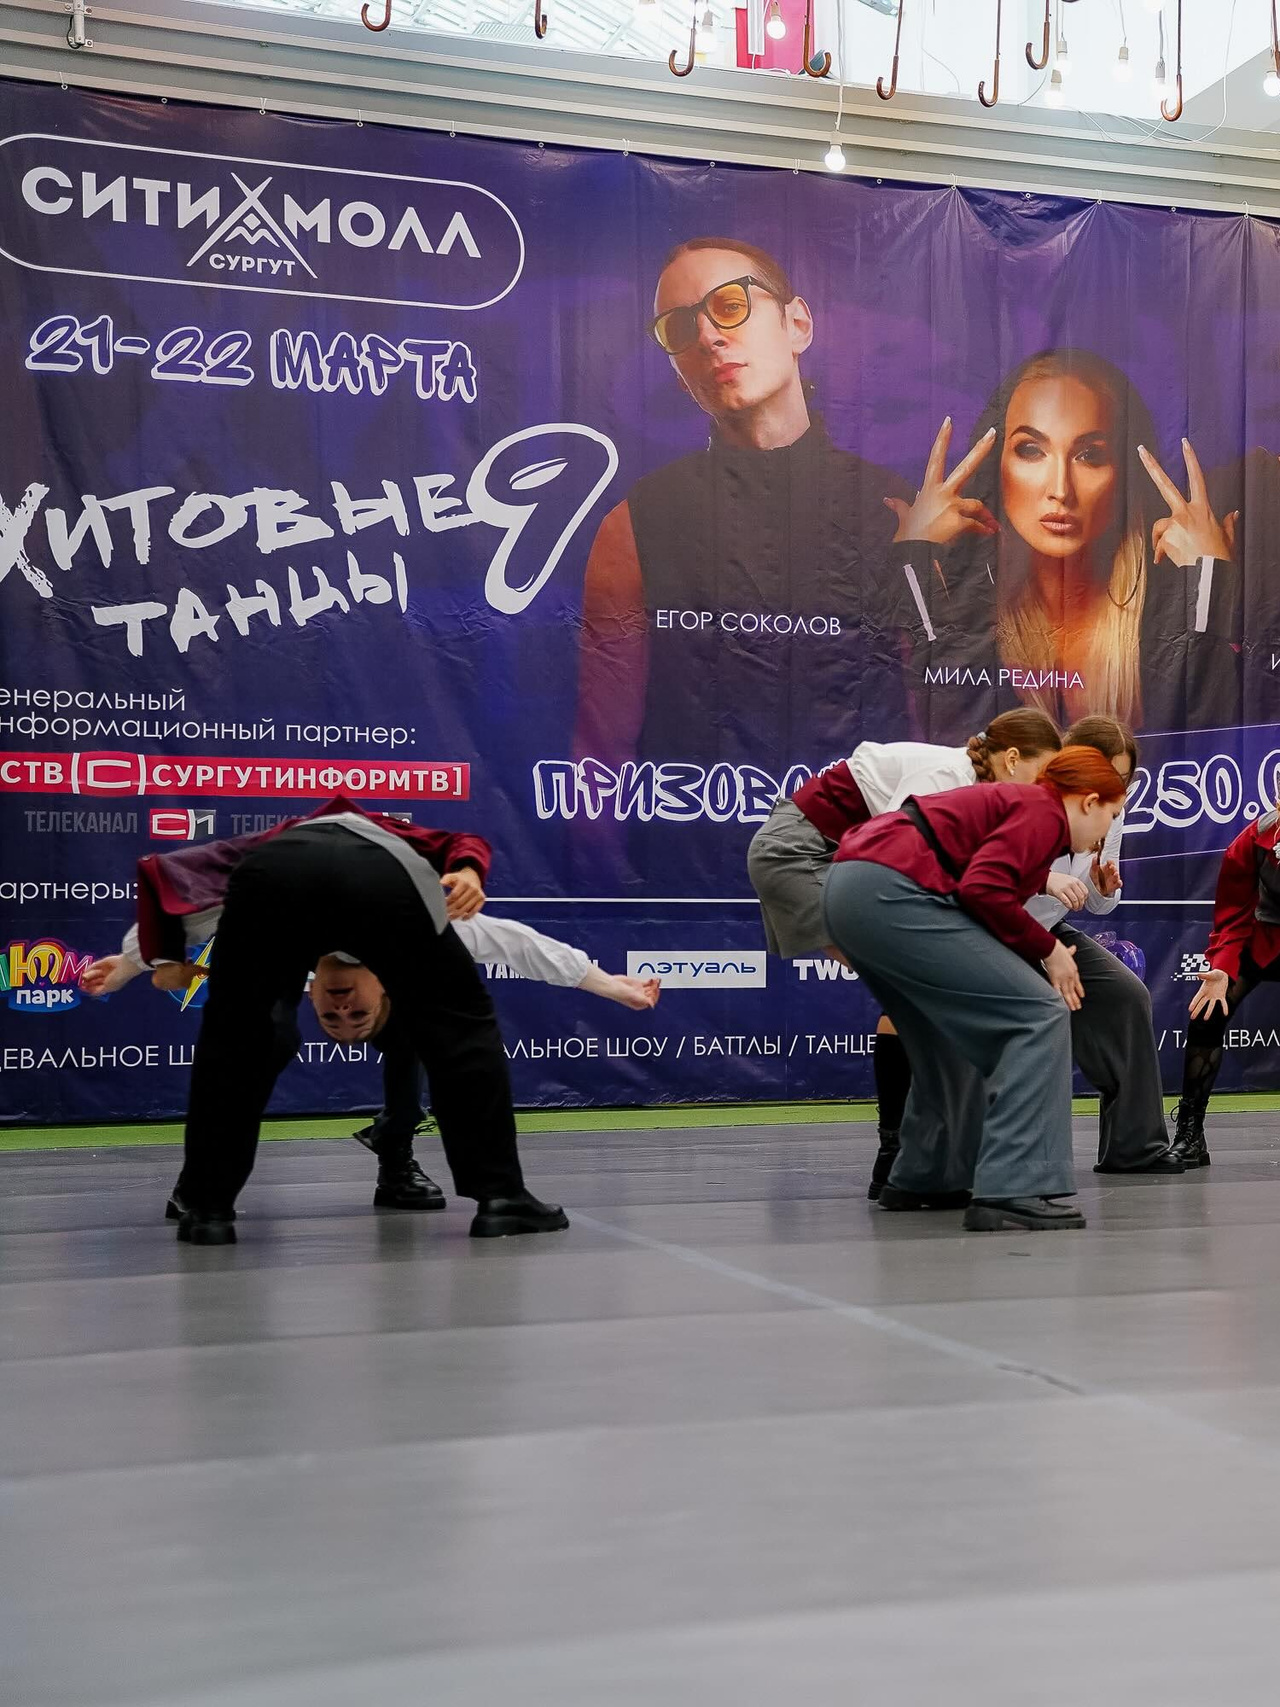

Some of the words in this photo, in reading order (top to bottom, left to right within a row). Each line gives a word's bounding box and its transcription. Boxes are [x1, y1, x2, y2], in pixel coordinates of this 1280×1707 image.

[21, 166, 220, 229] СИТИ
[284, 194, 481, 258] МОЛЛ
[209, 253, 296, 276] СУРГУТ
[25, 315, 254, 386] 21-22
[270, 329, 478, 403] МАРТА
[94, 550, 409, 656] ТАНЦЫ
[656, 609, 713, 630] ЕГОР
[720, 612, 841, 636] СОКОЛОВ
[924, 666, 992, 686] МИЛА
[999, 668, 1084, 690] РЕДИНА
[286, 723, 416, 749] партнер:
[533, 757, 852, 823] ПРИЗОВО
[24, 810, 138, 834] ТЕЛЕКАНАЛ
[16, 988, 74, 1008] парк
[0, 1045, 159, 1072] ЕВАЛЬНОЕ
[297, 1041, 367, 1063] ТТЛЫ
[606, 1037, 668, 1057] ШОУ
[694, 1035, 781, 1056] БАТТЛЫ
